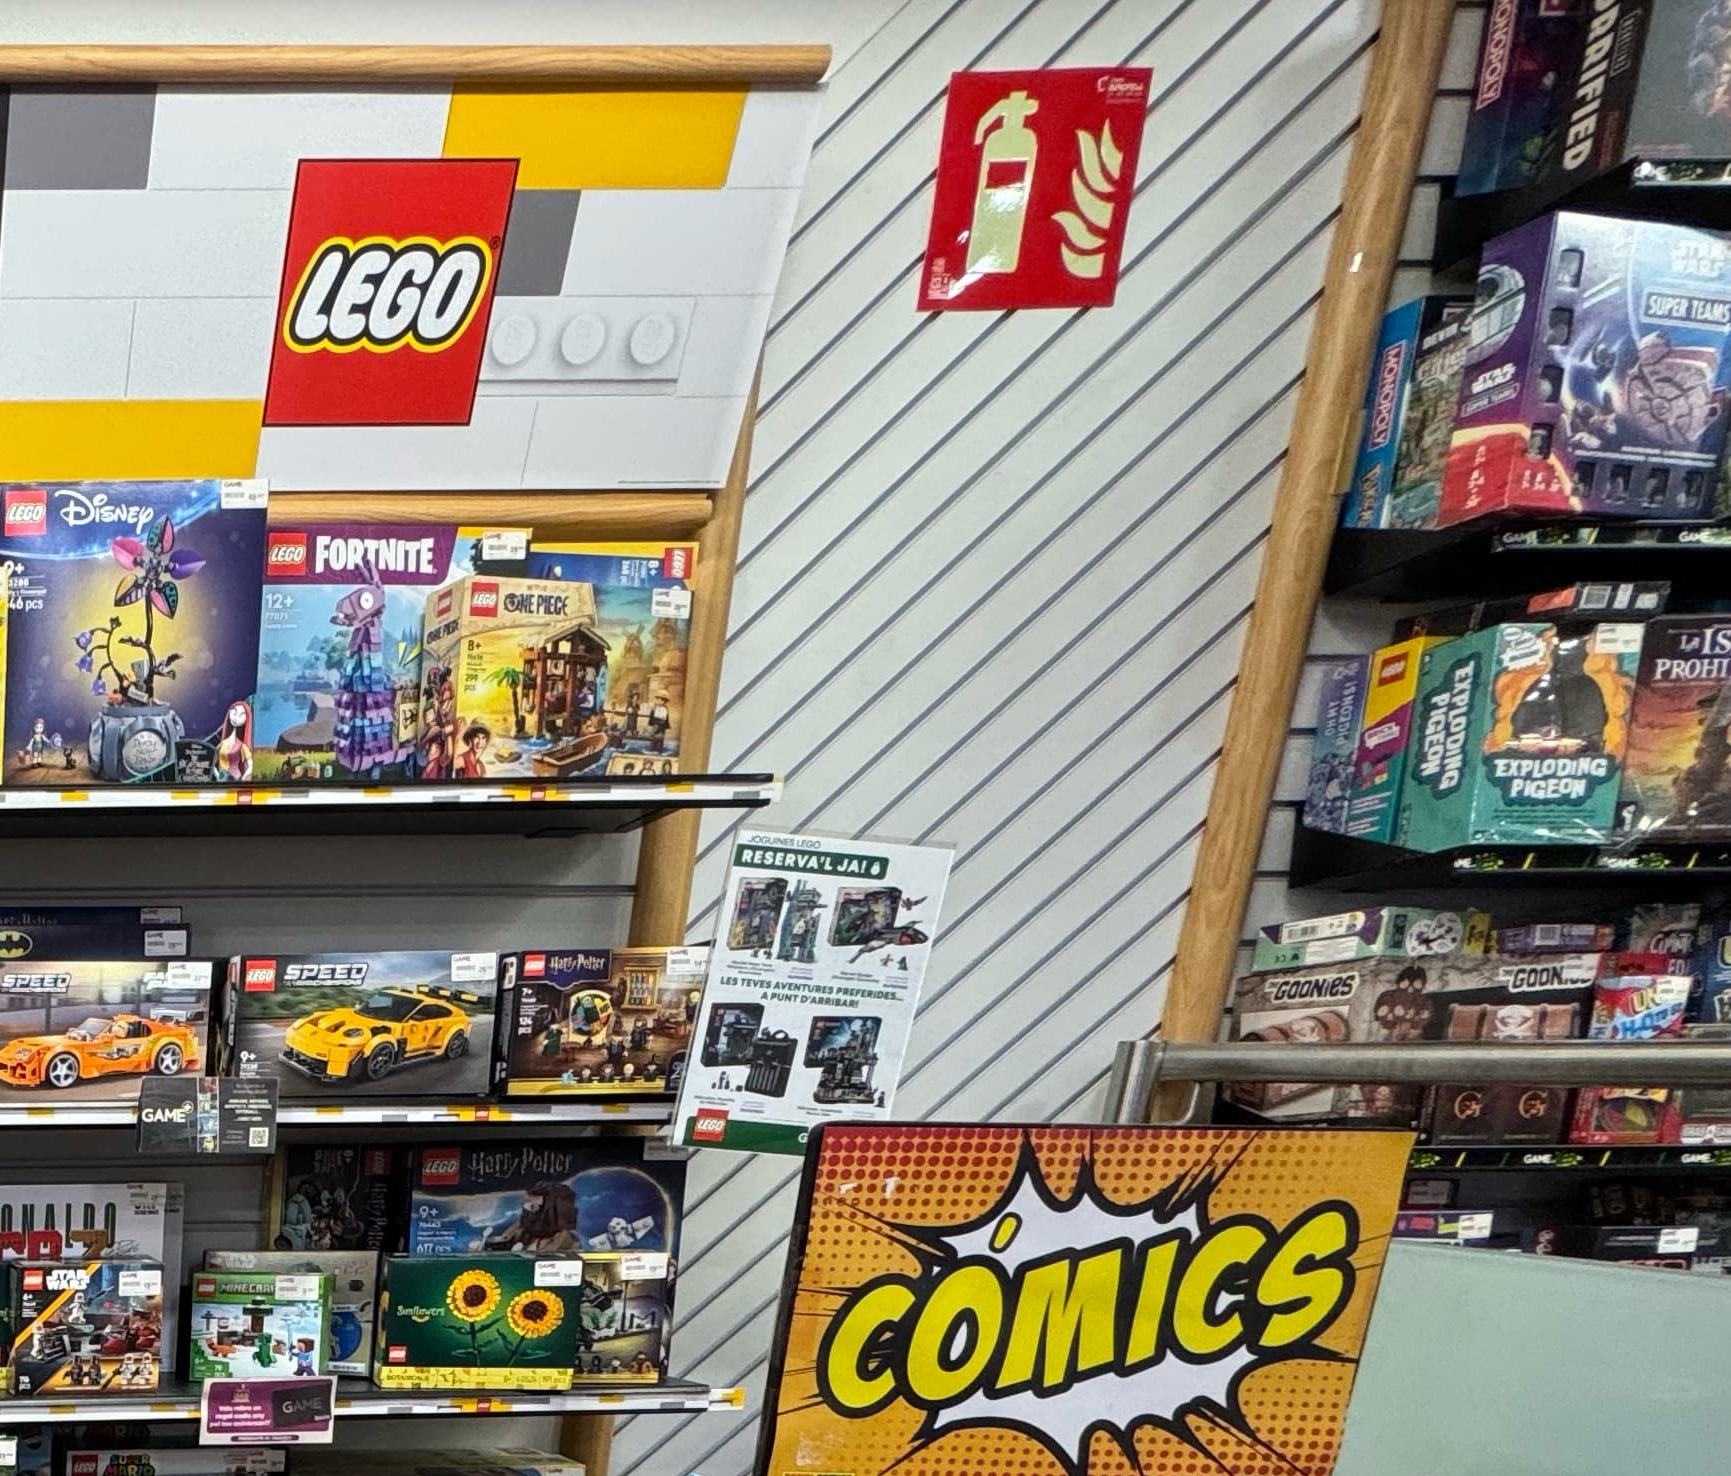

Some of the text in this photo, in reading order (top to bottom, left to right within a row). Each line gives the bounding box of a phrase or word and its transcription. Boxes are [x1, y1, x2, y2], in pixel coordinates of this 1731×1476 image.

[293, 244, 480, 345] LEGO
[1648, 296, 1729, 323] SUPER TEAMS
[1371, 345, 1403, 449] MONOPOLY
[7, 509, 45, 523] LEGO
[55, 490, 154, 534] Disney
[271, 546, 304, 562] LEGO
[315, 536, 435, 574] FORTNITE
[471, 593, 497, 606] LEGO
[503, 594, 568, 616] ONE PIECE
[1421, 693, 1450, 777] PIGEON
[1439, 666, 1474, 790] EXPLODING
[1494, 759, 1608, 779] EXPLODING
[1511, 779, 1585, 799] PIGEON
[748, 835, 821, 849] JOGUINES LEGO
[741, 850, 867, 873] RESERVA'L JA!
[285, 963, 368, 980] SPEED
[549, 955, 605, 974] Harry Potter
[2, 973, 71, 988] SPEED
[246, 967, 274, 984] LEGO
[720, 977, 738, 987] LES
[740, 978, 771, 989] TEVES
[773, 981, 833, 995] AVENTURES
[1273, 975, 1354, 999] GOONIES
[770, 993, 798, 1003] PUNT
[800, 995, 859, 1008] D'ARRIBAR!
[141, 1107, 186, 1124] GAME
[697, 1119, 725, 1131] LEGO
[423, 1160, 458, 1175] LEGO
[469, 1150, 572, 1177] Harry Potter
[47, 1269, 89, 1279] STAR
[46, 1279, 86, 1290] WARS
[397, 1305, 444, 1322] Sunflowers
[827, 1211, 1348, 1409] CÓMICS
[282, 1397, 322, 1414] GAME
